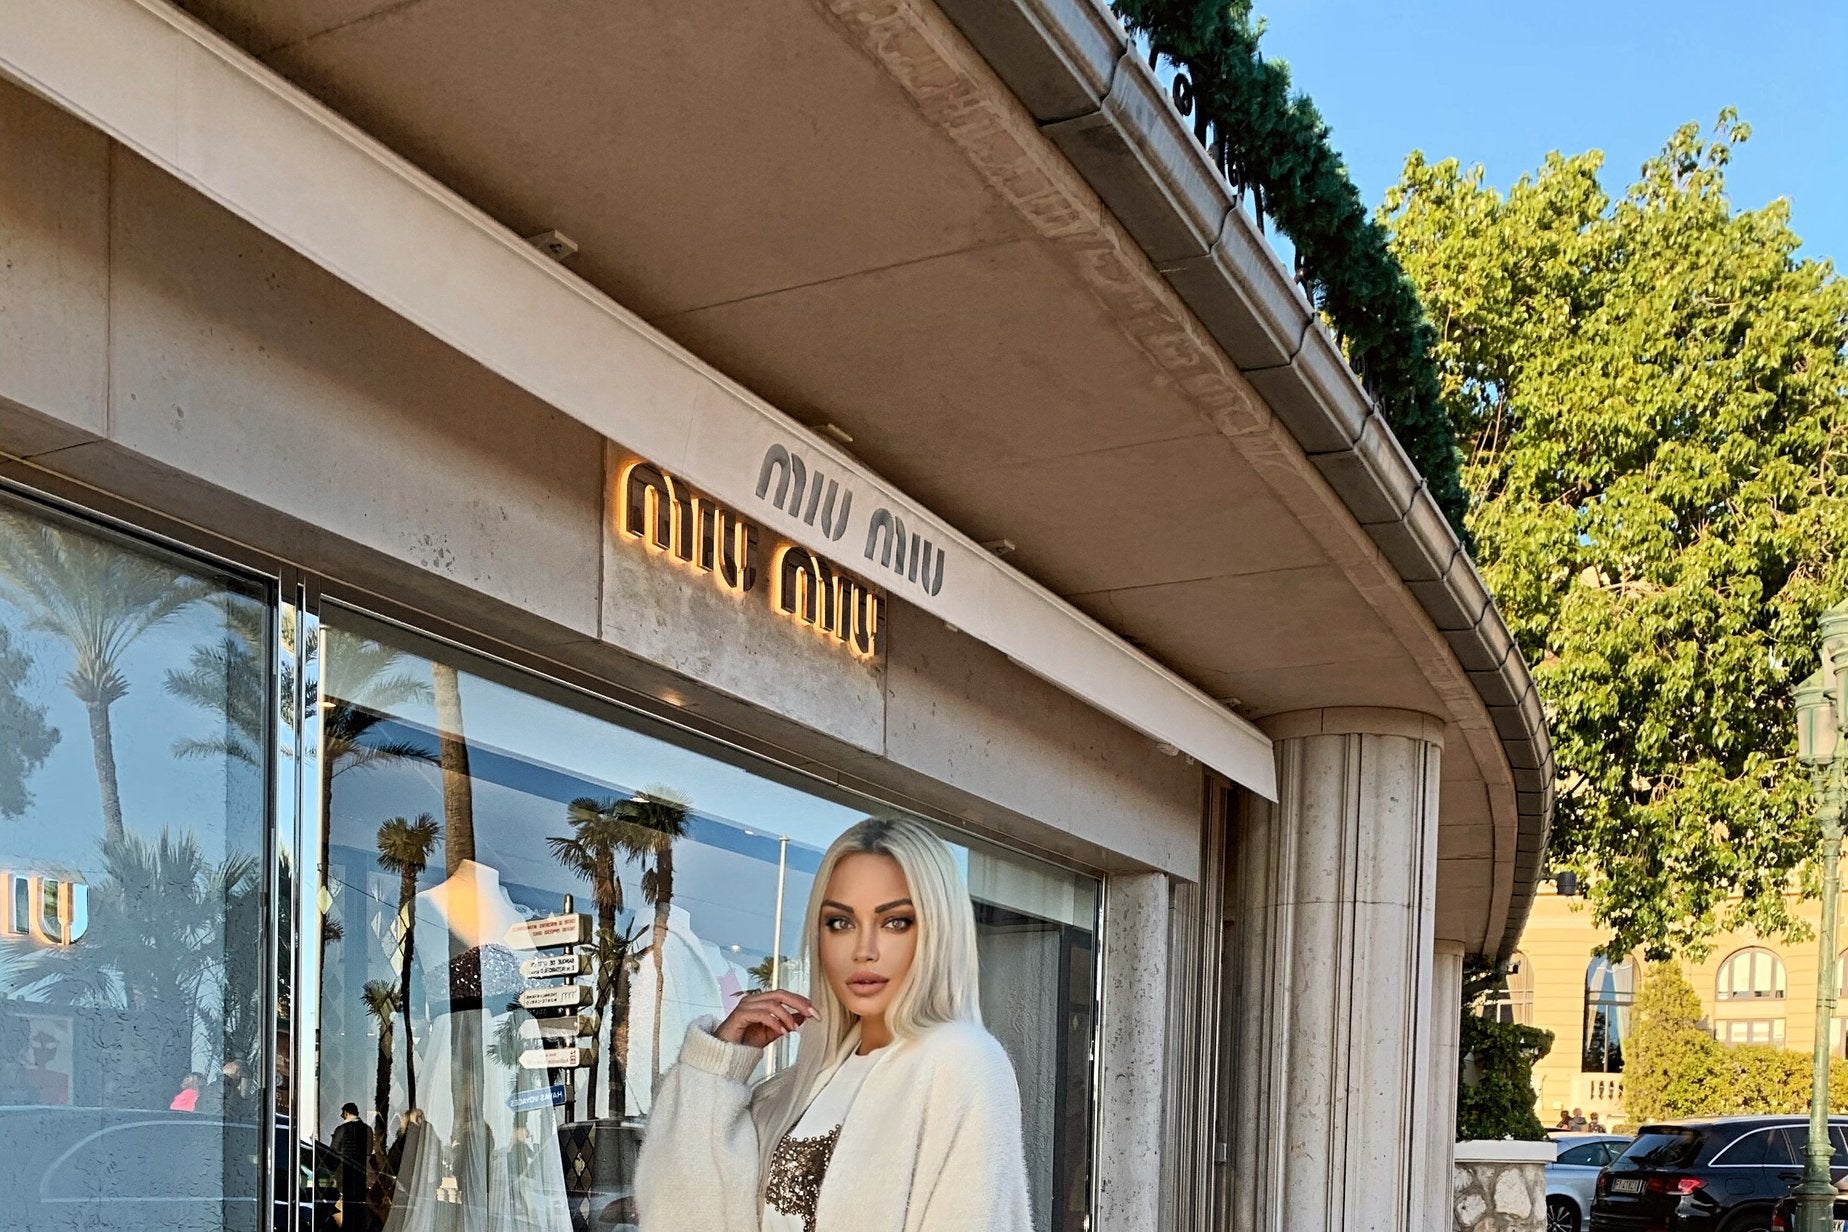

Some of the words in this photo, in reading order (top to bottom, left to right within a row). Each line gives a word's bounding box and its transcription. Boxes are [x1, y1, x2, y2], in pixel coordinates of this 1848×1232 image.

[622, 462, 758, 593] MIU
[778, 545, 885, 657] MIU
[755, 443, 852, 542] MIU
[864, 507, 945, 597] MIU
